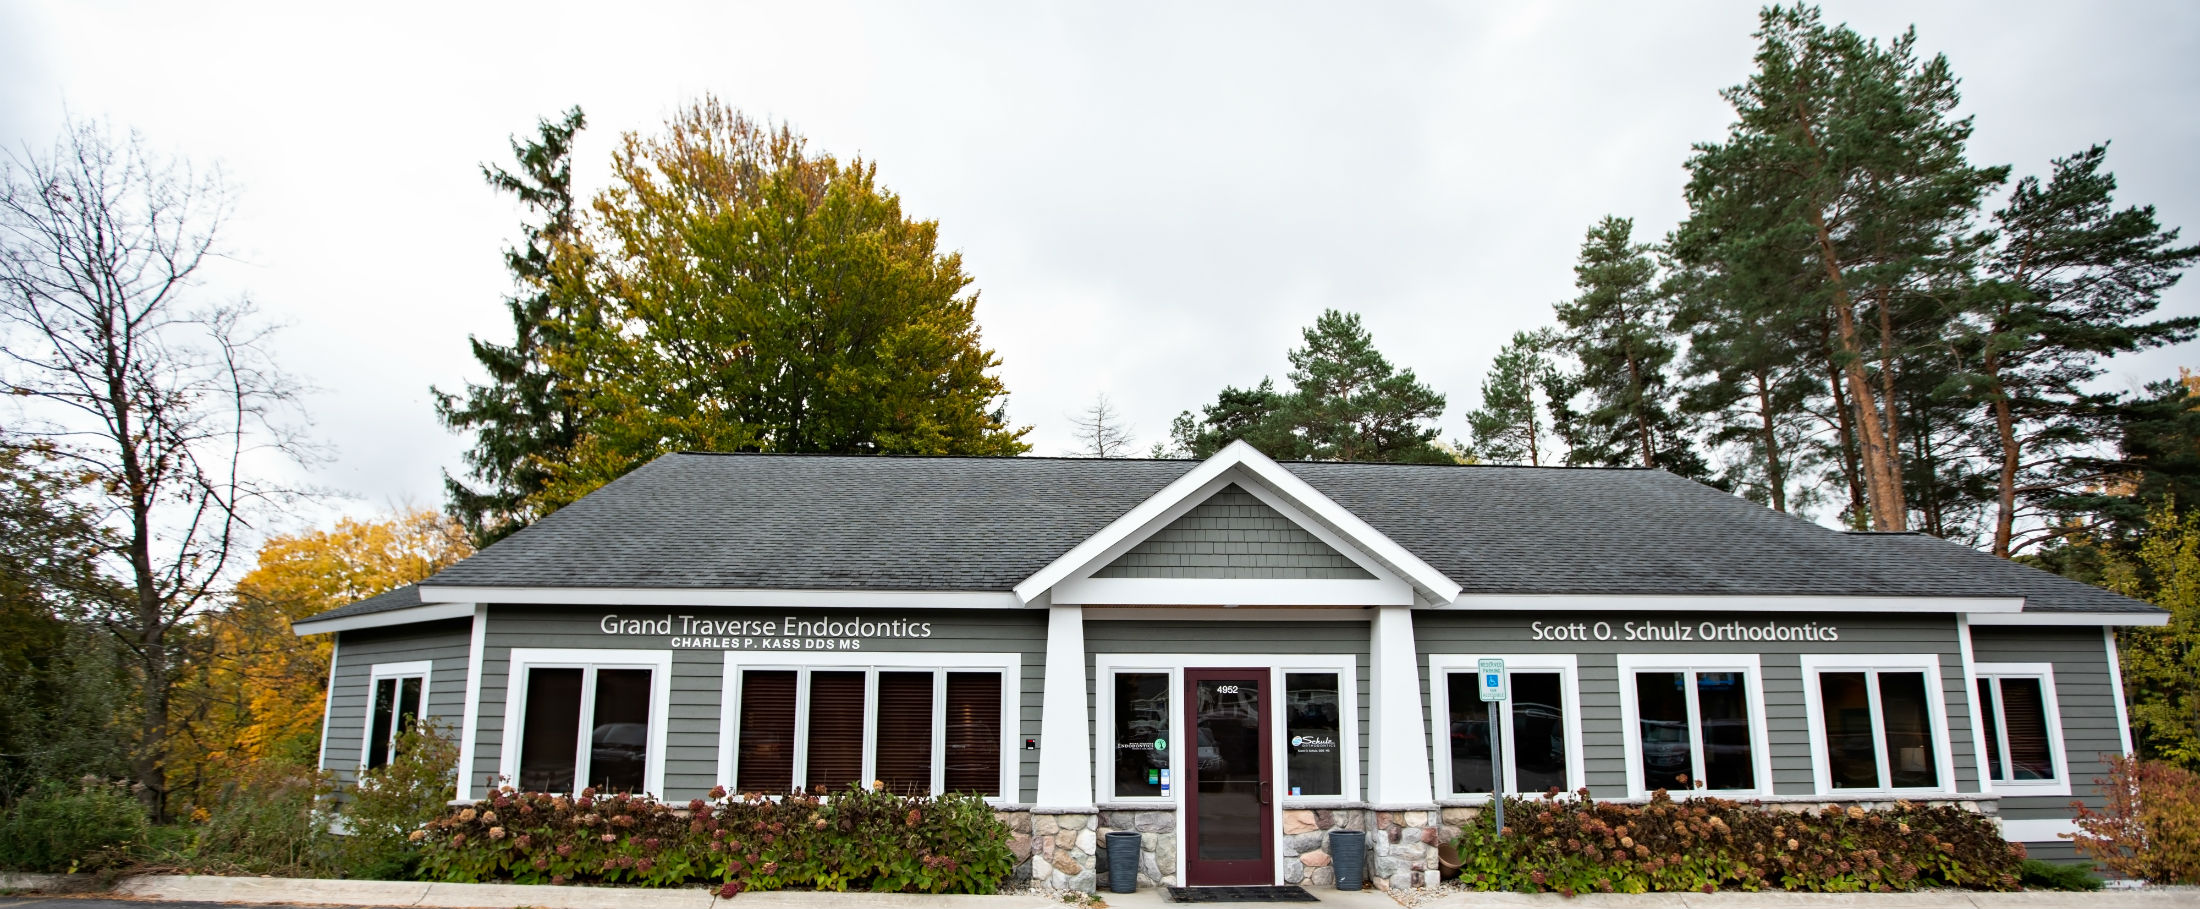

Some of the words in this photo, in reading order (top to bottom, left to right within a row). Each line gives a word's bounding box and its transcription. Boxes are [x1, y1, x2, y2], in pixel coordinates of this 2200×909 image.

[601, 614, 672, 635] Grand
[679, 615, 776, 636] Traverse
[783, 616, 932, 638] Endodontics
[1531, 621, 1588, 641] Scott
[1593, 621, 1618, 641] O.
[1624, 620, 1694, 641] Schulz
[1699, 621, 1839, 641] Orthodontics
[671, 637, 740, 649] CHARLES
[744, 638, 758, 649] P.
[762, 638, 801, 650] KASS
[804, 638, 835, 650] DDS
[839, 638, 861, 650] MS
[1216, 685, 1239, 694] 4952
[1301, 735, 1334, 744] Schulz
